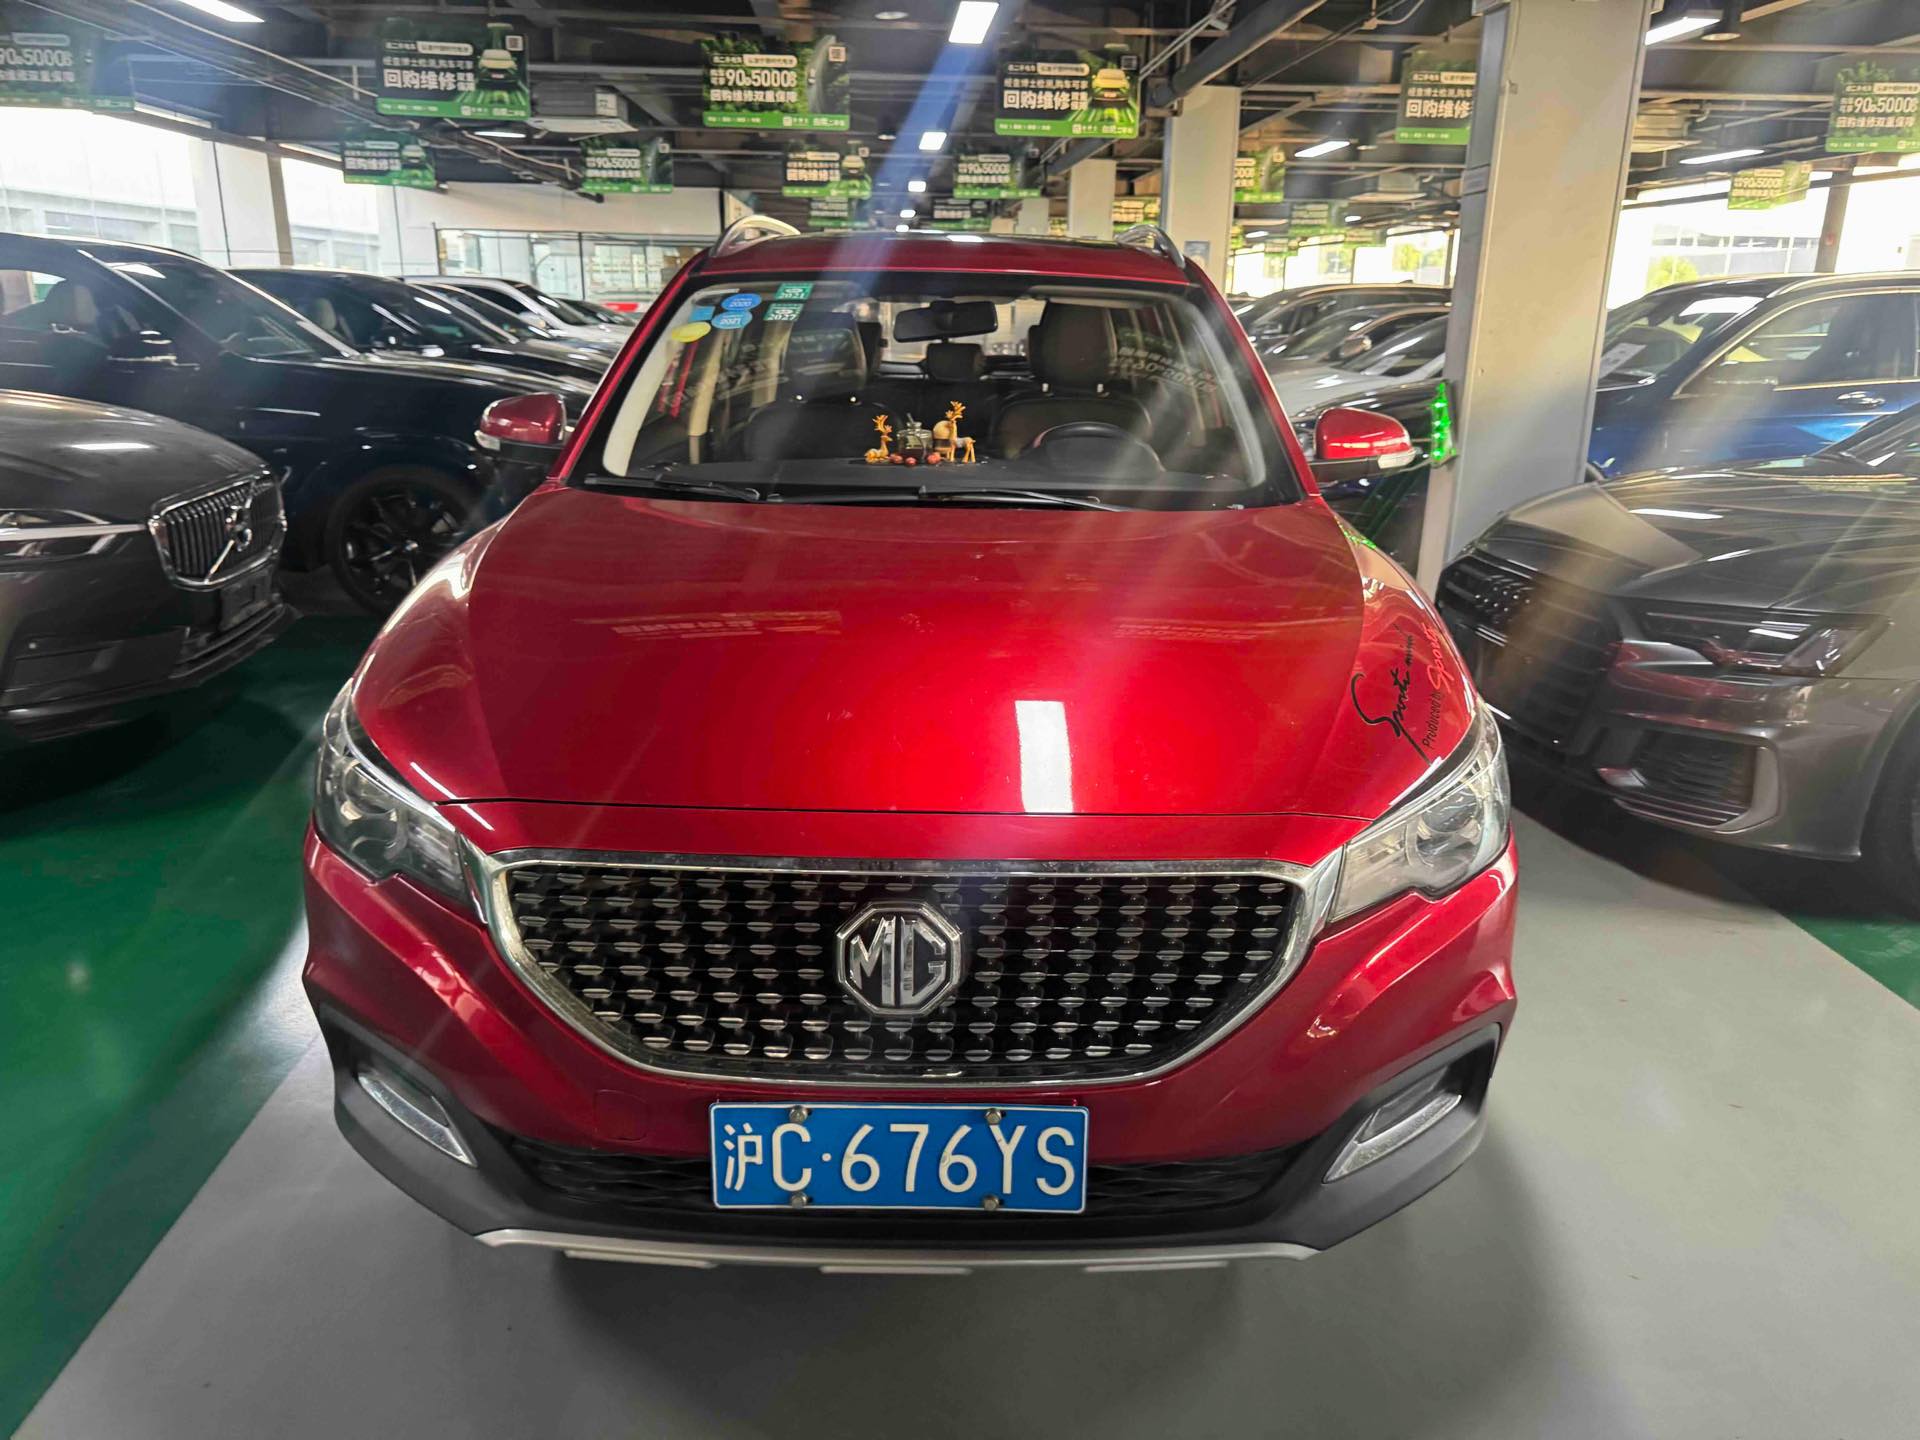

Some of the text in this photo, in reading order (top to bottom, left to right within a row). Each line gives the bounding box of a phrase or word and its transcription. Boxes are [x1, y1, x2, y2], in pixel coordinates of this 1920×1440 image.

[384, 69, 457, 91] 回购维修
[1004, 90, 1071, 110] 回购维修
[1406, 99, 1472, 118] 回购维修
[1422, 702, 1441, 750] Produced
[849, 914, 947, 1007] MG
